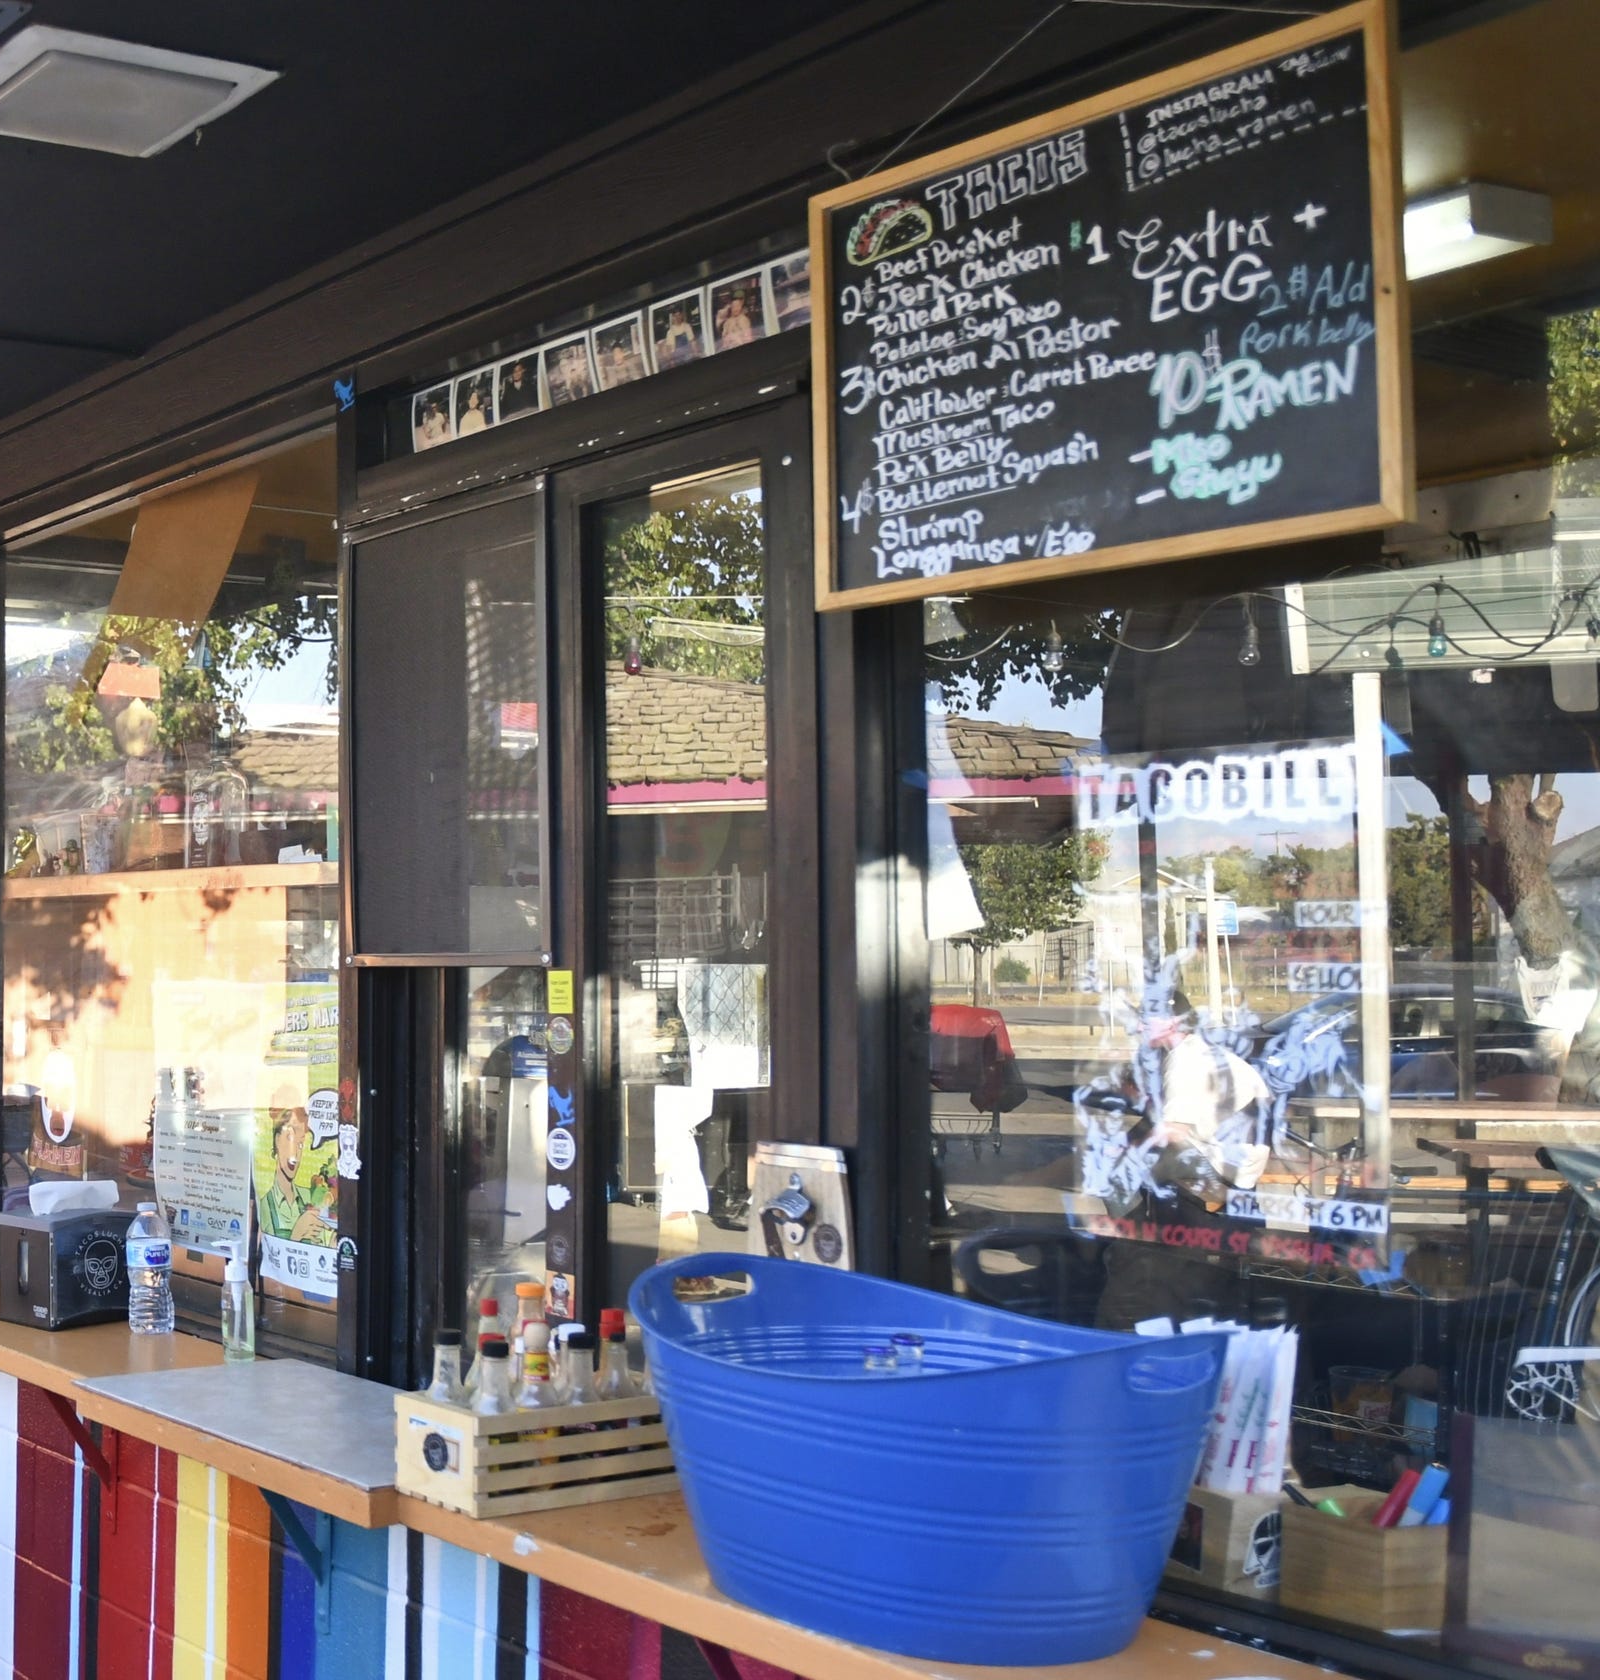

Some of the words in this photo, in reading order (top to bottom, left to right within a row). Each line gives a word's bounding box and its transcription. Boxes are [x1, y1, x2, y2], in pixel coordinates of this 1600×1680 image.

[1146, 68, 1275, 128] INSTAGRAM
[926, 129, 1089, 231] TACOS
[874, 246, 928, 283] Beef
[929, 216, 1022, 268] Brisket
[1117, 208, 1274, 280] Extra
[878, 274, 956, 313] Jerk
[960, 244, 1060, 289] Chicken
[1150, 253, 1272, 323] EGG
[866, 297, 948, 338] Pulled
[948, 284, 1017, 317] Pork
[877, 350, 978, 396] Chicken
[1018, 316, 1121, 360] Pastor
[1010, 356, 1087, 397] Carrot
[1087, 350, 1157, 380] Puree
[1205, 344, 1360, 431] RAMEN
[872, 416, 992, 460] Mushroom
[992, 400, 1056, 433] Taco
[931, 436, 1013, 474] Belly
[1002, 431, 1099, 484] Squash
[878, 508, 984, 551] Shrimp
[1080, 750, 1360, 823] TACOBILL
[318, 1120, 334, 1131] 1979
[75, 1230, 100, 1256] TACOS
[101, 1230, 126, 1251] LUCHA
[1162, 1223, 1224, 1251] COURT
[1330, 1204, 1344, 1226] 6
[1350, 1205, 1384, 1229] PM
